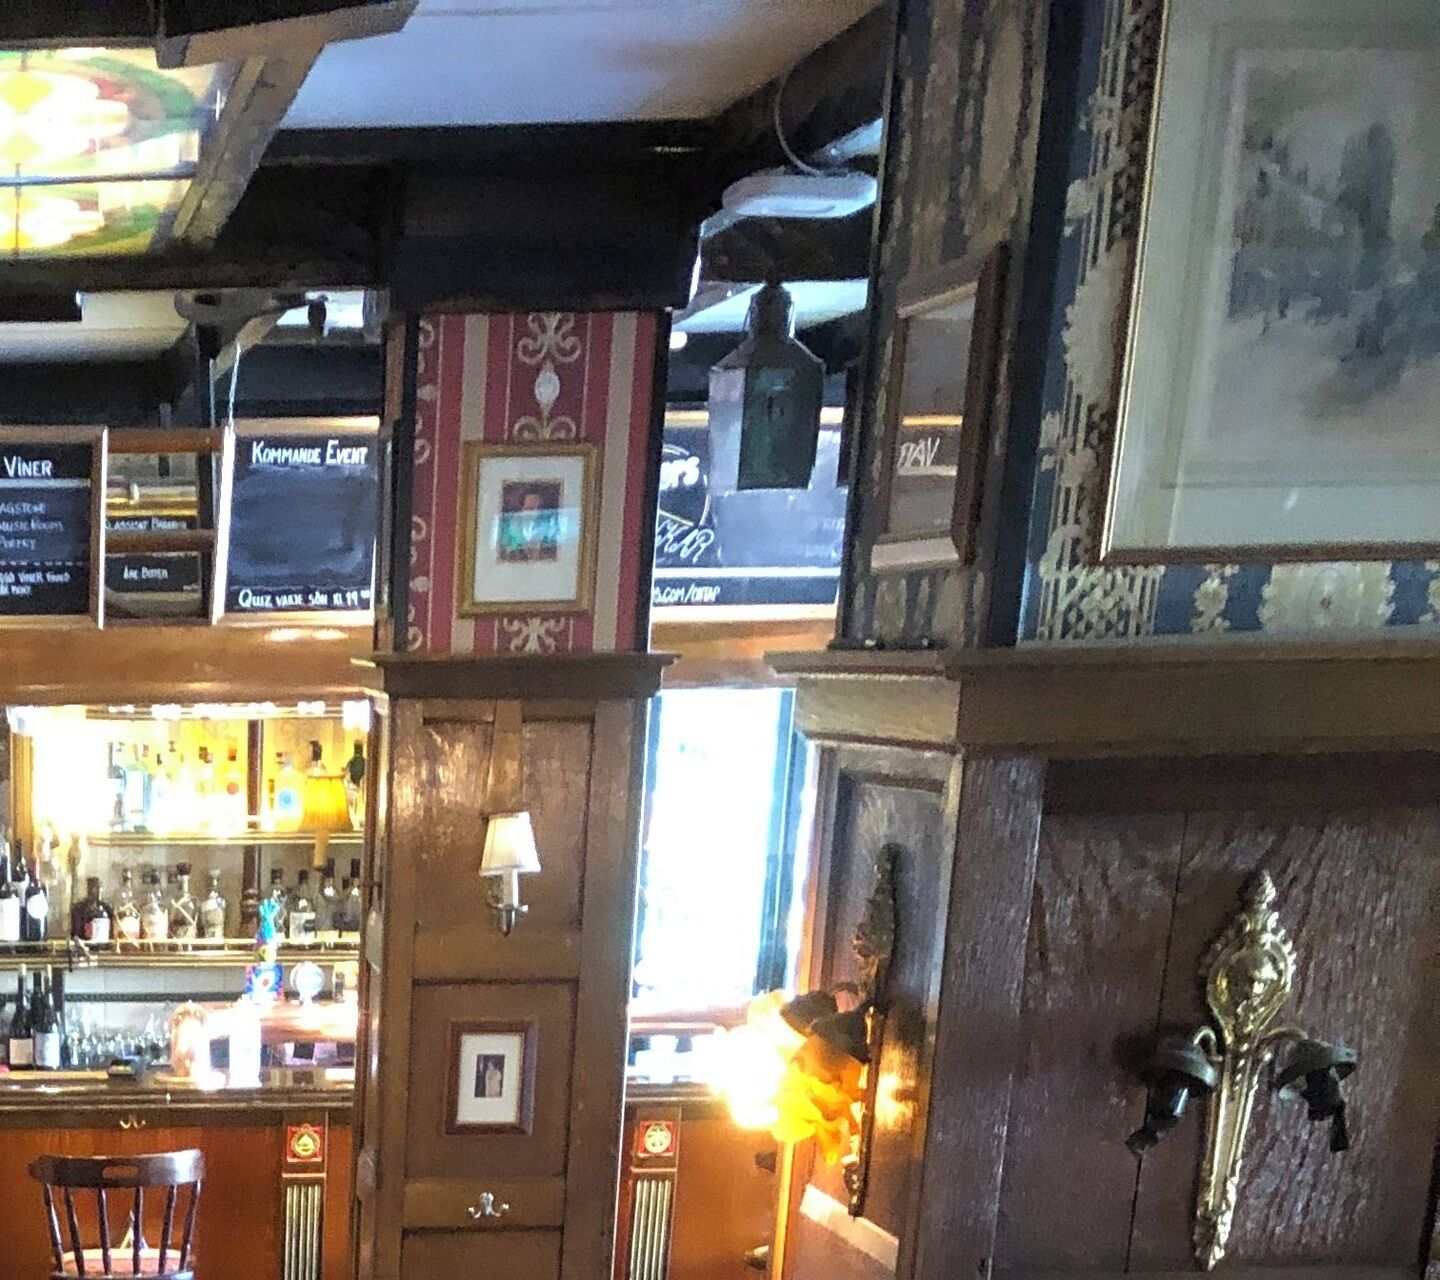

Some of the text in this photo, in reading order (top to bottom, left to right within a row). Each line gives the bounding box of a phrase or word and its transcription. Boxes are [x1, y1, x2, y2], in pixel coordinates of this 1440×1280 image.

[252, 439, 368, 465] KOMMANDE EVENT
[3, 456, 52, 477] VINER
